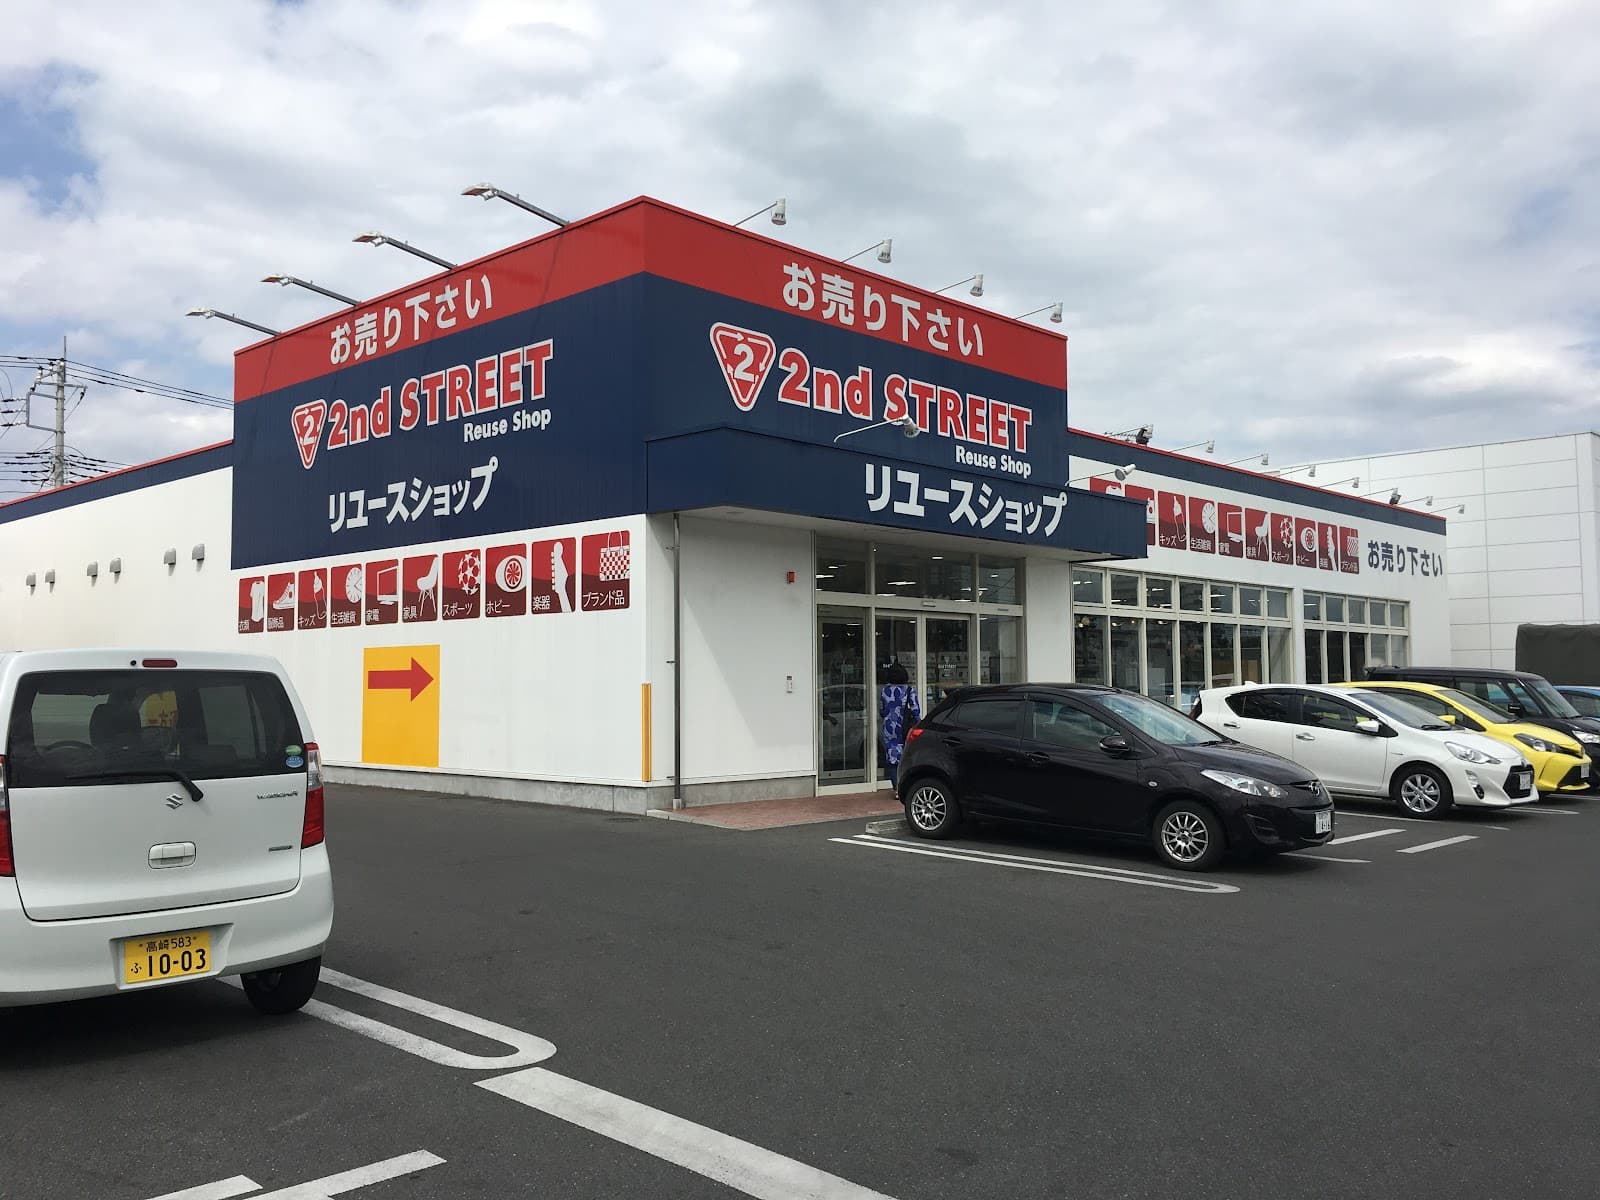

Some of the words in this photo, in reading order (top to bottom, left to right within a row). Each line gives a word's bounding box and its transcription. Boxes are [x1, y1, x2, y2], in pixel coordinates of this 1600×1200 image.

[330, 275, 493, 365] お売り下さい
[782, 262, 984, 357] お売り下さい
[732, 343, 756, 384] 2
[327, 385, 392, 451] 2nd
[399, 338, 554, 431] STREET
[778, 347, 873, 421] 2nd
[883, 373, 1032, 454] STREET
[300, 414, 317, 445] 2
[463, 416, 508, 443] Reuse
[512, 408, 552, 434] Shop
[955, 445, 997, 470] Reuse
[1000, 454, 1032, 479] Shop
[329, 455, 499, 534] リユースショップ
[865, 463, 1068, 537] リユースショップ
[1159, 533, 1177, 546] キッズ
[1272, 550, 1290, 562] スポーツ
[1367, 539, 1443, 577] お売り下さい
[403, 605, 418, 619] 家具
[442, 601, 474, 617] スポーツ
[486, 599, 511, 615] ホビー
[532, 594, 551, 611] 楽器
[582, 589, 625, 608] ブランド品
[298, 614, 317, 627] キッズ
[330, 611, 357, 625] 生活雑貨
[365, 608, 380, 622] 家電
[130, 962, 142, 974] ふ
[148, 948, 206, 977] 10-03
